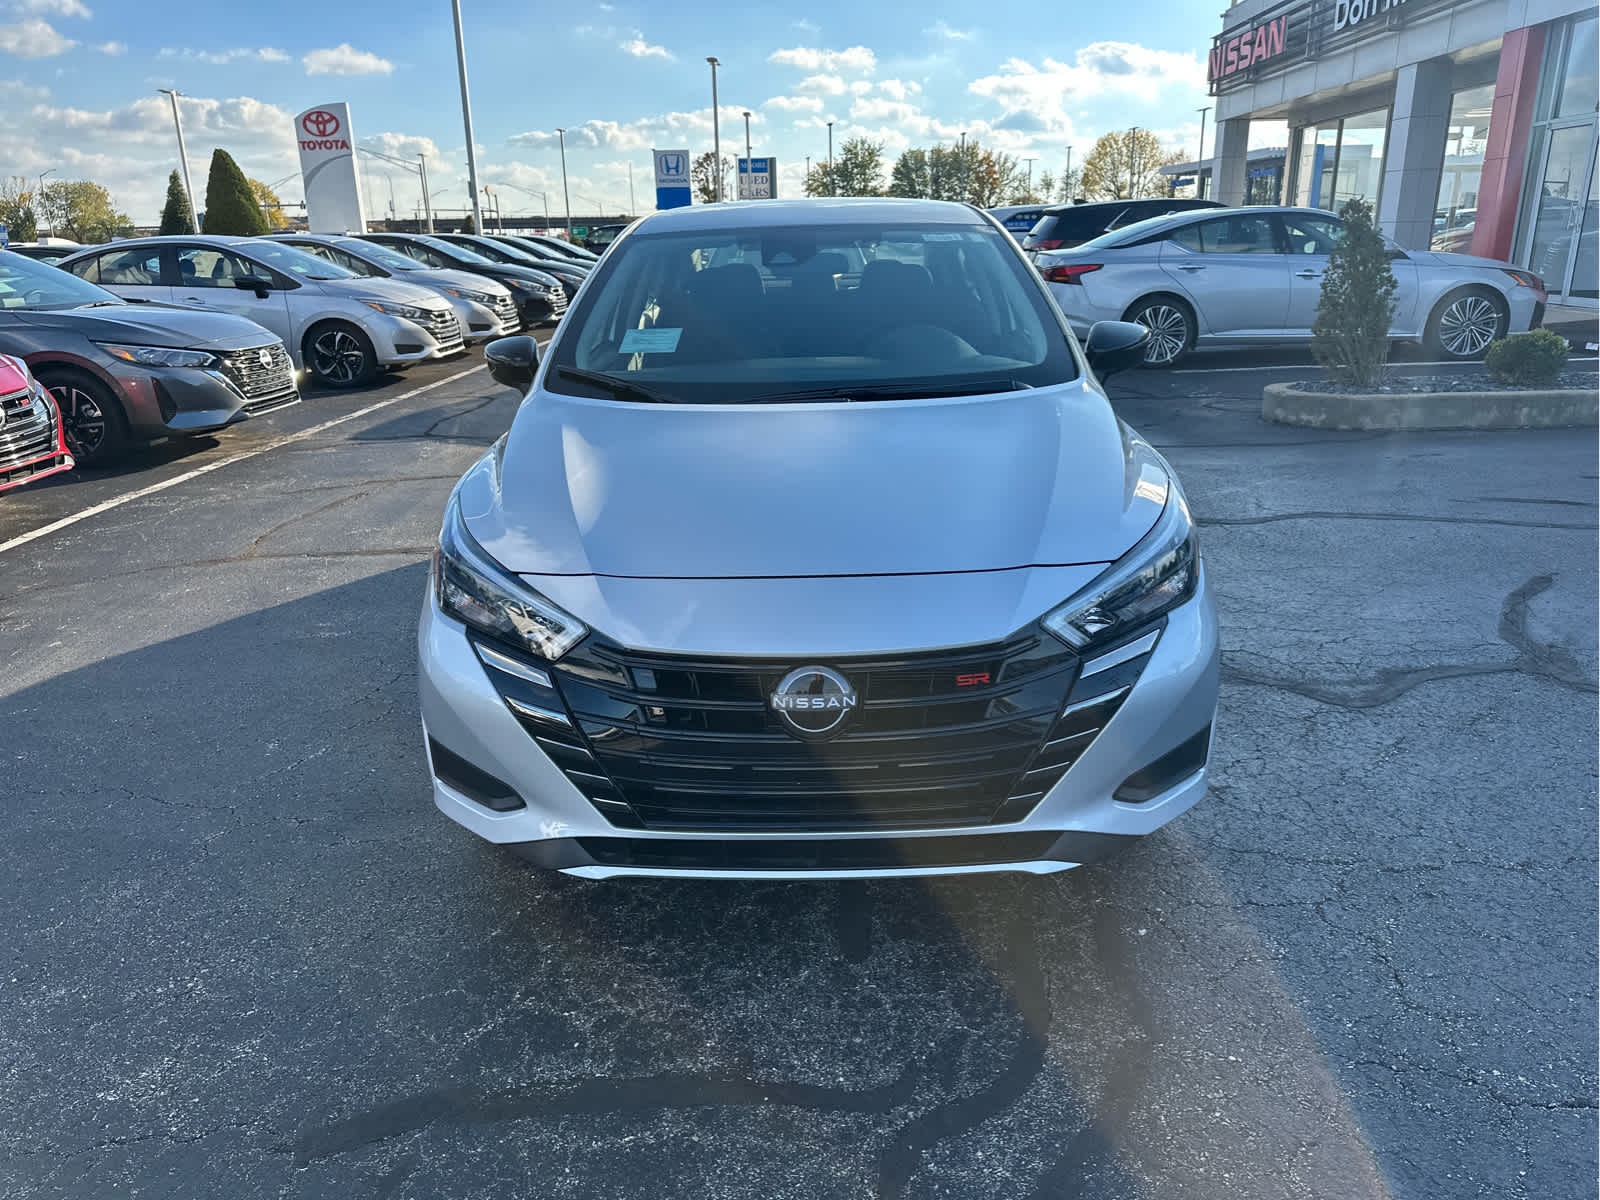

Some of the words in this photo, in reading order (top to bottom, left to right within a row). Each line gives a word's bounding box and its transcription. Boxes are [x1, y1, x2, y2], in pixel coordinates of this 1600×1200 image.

[1335, 0, 1377, 31] Don
[1208, 16, 1286, 81] NISSAN
[298, 140, 349, 151] TOYOTA
[956, 672, 990, 687] SR
[773, 695, 856, 709] NISSAN
